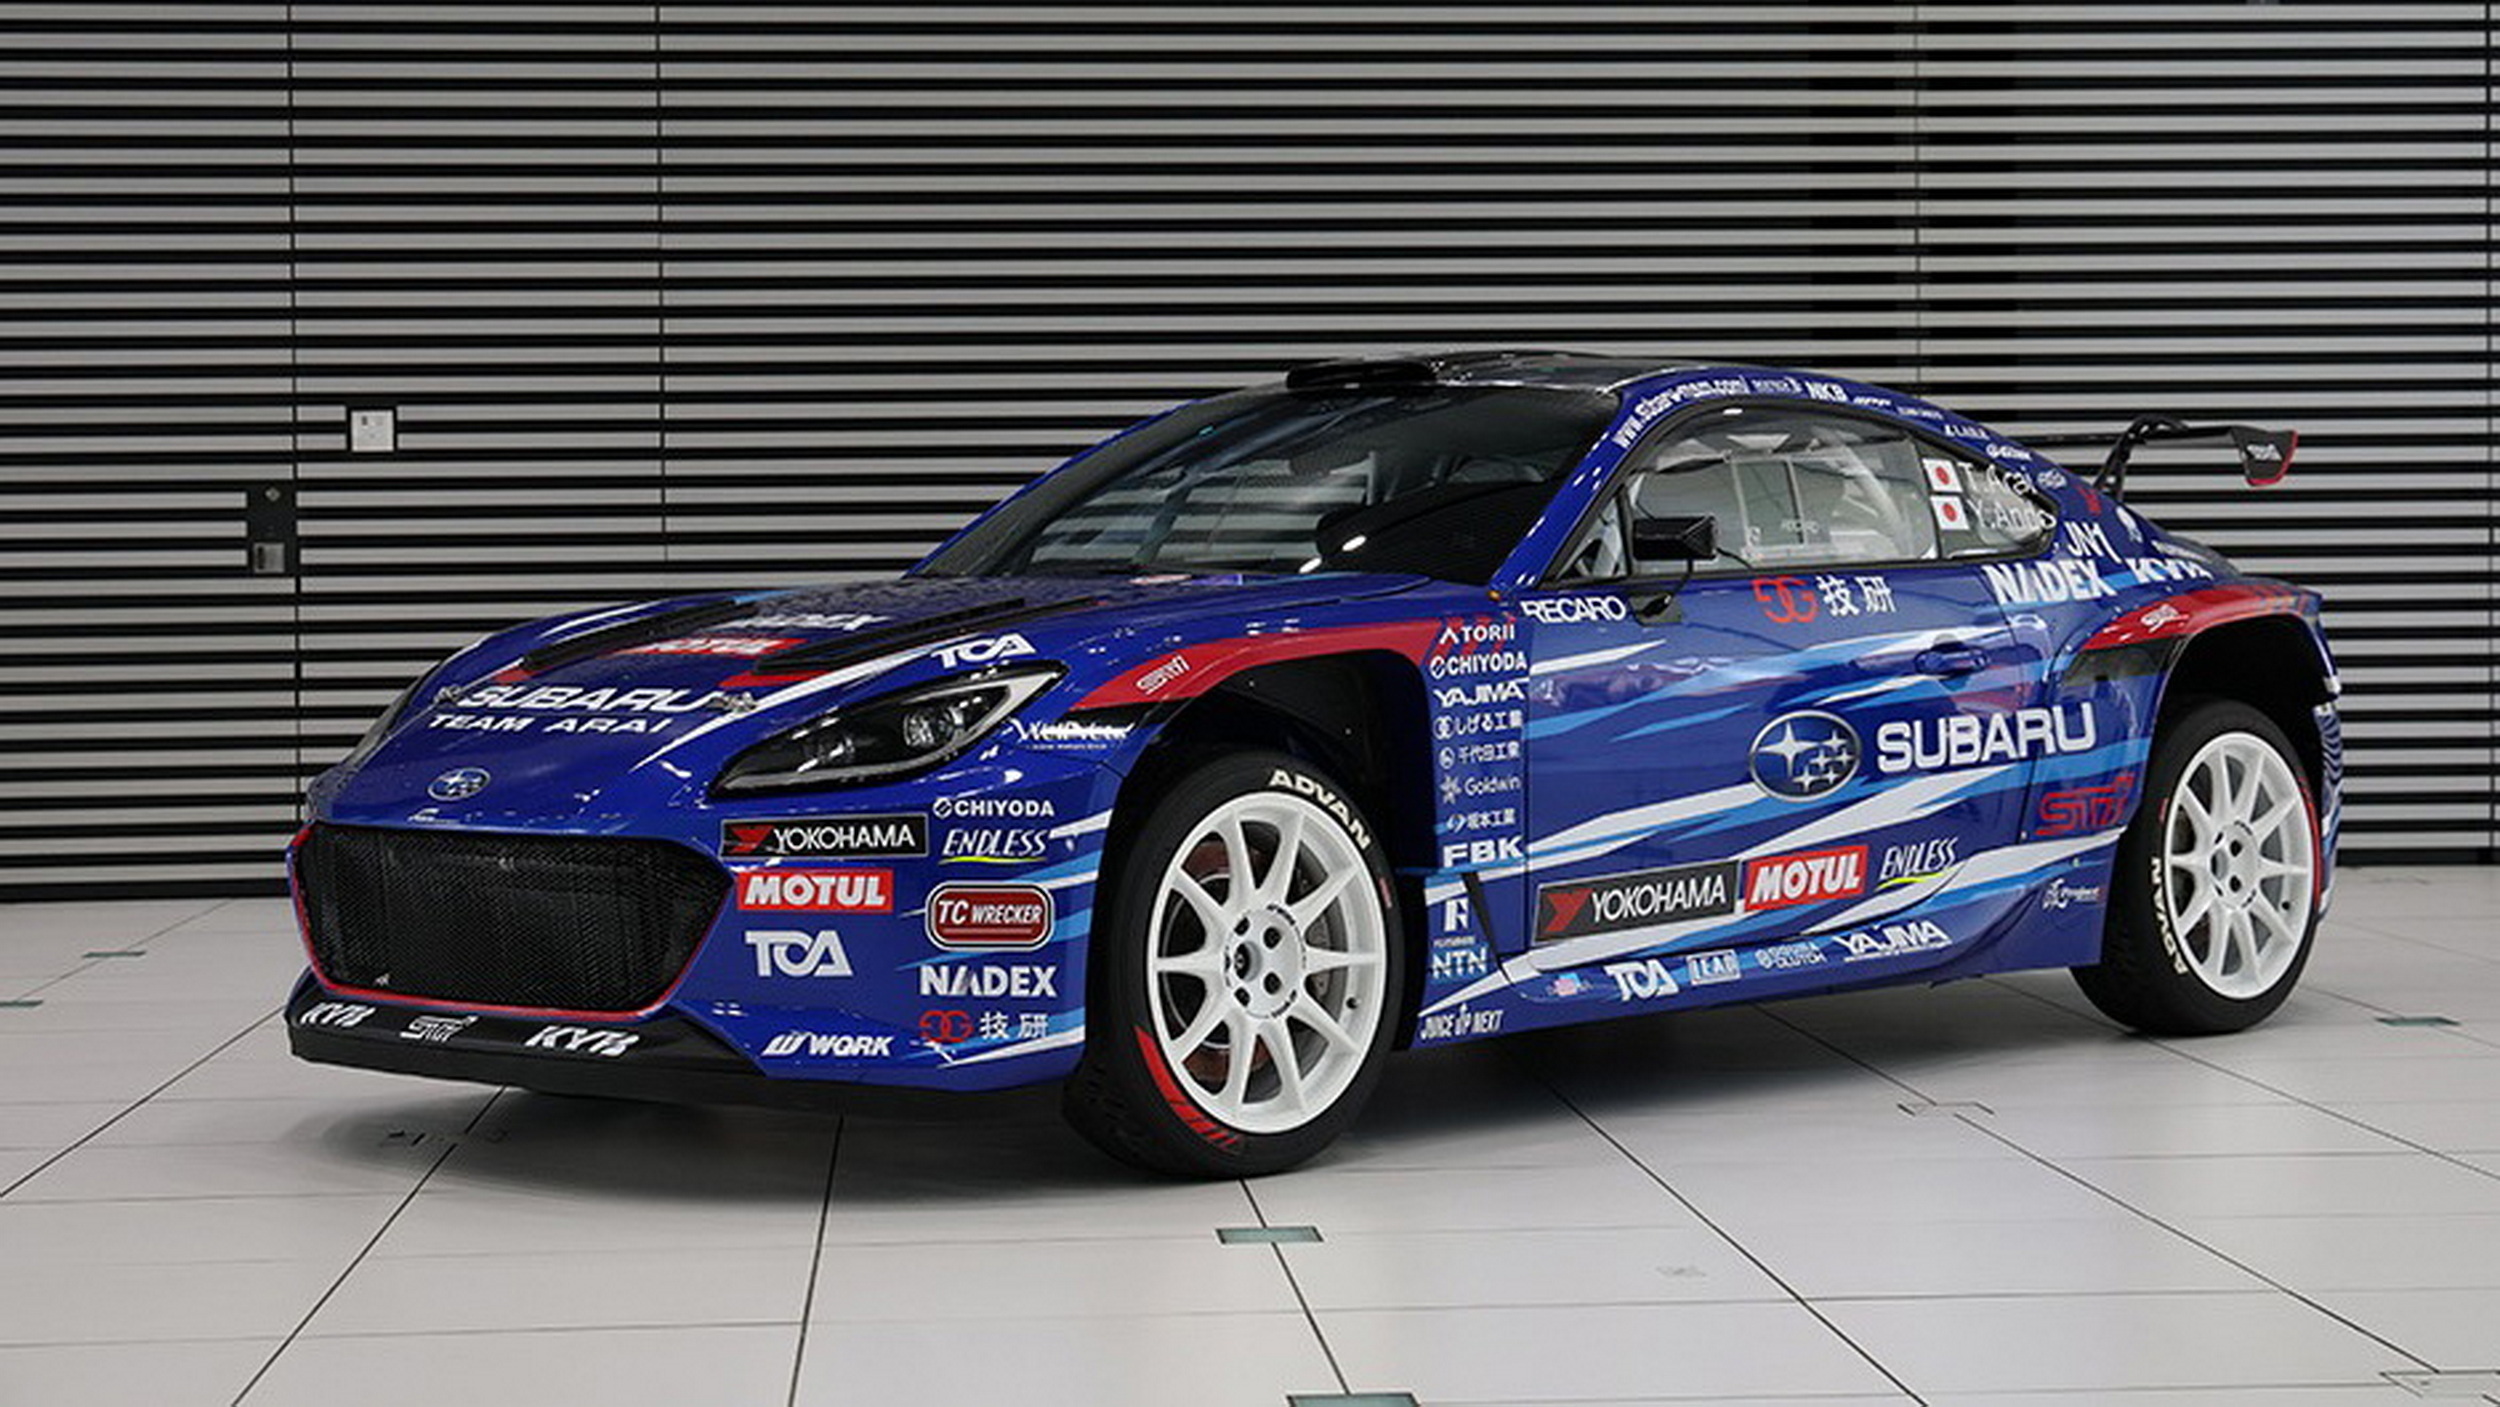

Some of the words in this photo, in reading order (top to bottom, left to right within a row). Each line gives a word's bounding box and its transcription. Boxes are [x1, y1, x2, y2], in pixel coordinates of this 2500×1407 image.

[1980, 556, 2118, 605] NADEX
[1520, 595, 1627, 624] RECARO
[1449, 651, 1528, 677] CHIYODA
[457, 685, 726, 712] SUBARU
[429, 714, 535, 731] TEAM
[543, 717, 674, 734] ARAI
[1876, 701, 2098, 773] SUBARU
[954, 799, 1056, 818] CHIYODA
[1268, 769, 1372, 851] ADVAN
[774, 823, 917, 852] YOKOHAMA
[942, 828, 1049, 857] ENDLESS
[1443, 837, 1525, 868] FBK
[1879, 838, 1958, 876] ENDLESS
[745, 874, 887, 905] MOTUL
[1749, 851, 1862, 903] MOTUL
[938, 899, 969, 925] TC
[971, 902, 1044, 926] WRECKER
[1592, 874, 1727, 923] YOKOHAMA
[2151, 857, 2188, 974] ADVAN
[1832, 921, 1950, 955] YAJIMA
[1432, 947, 1487, 979] NTN
[919, 966, 1058, 996] NADEX
[525, 1024, 641, 1057] KYB
[979, 1011, 1050, 1040] 技研
[810, 1034, 895, 1057] WORK
